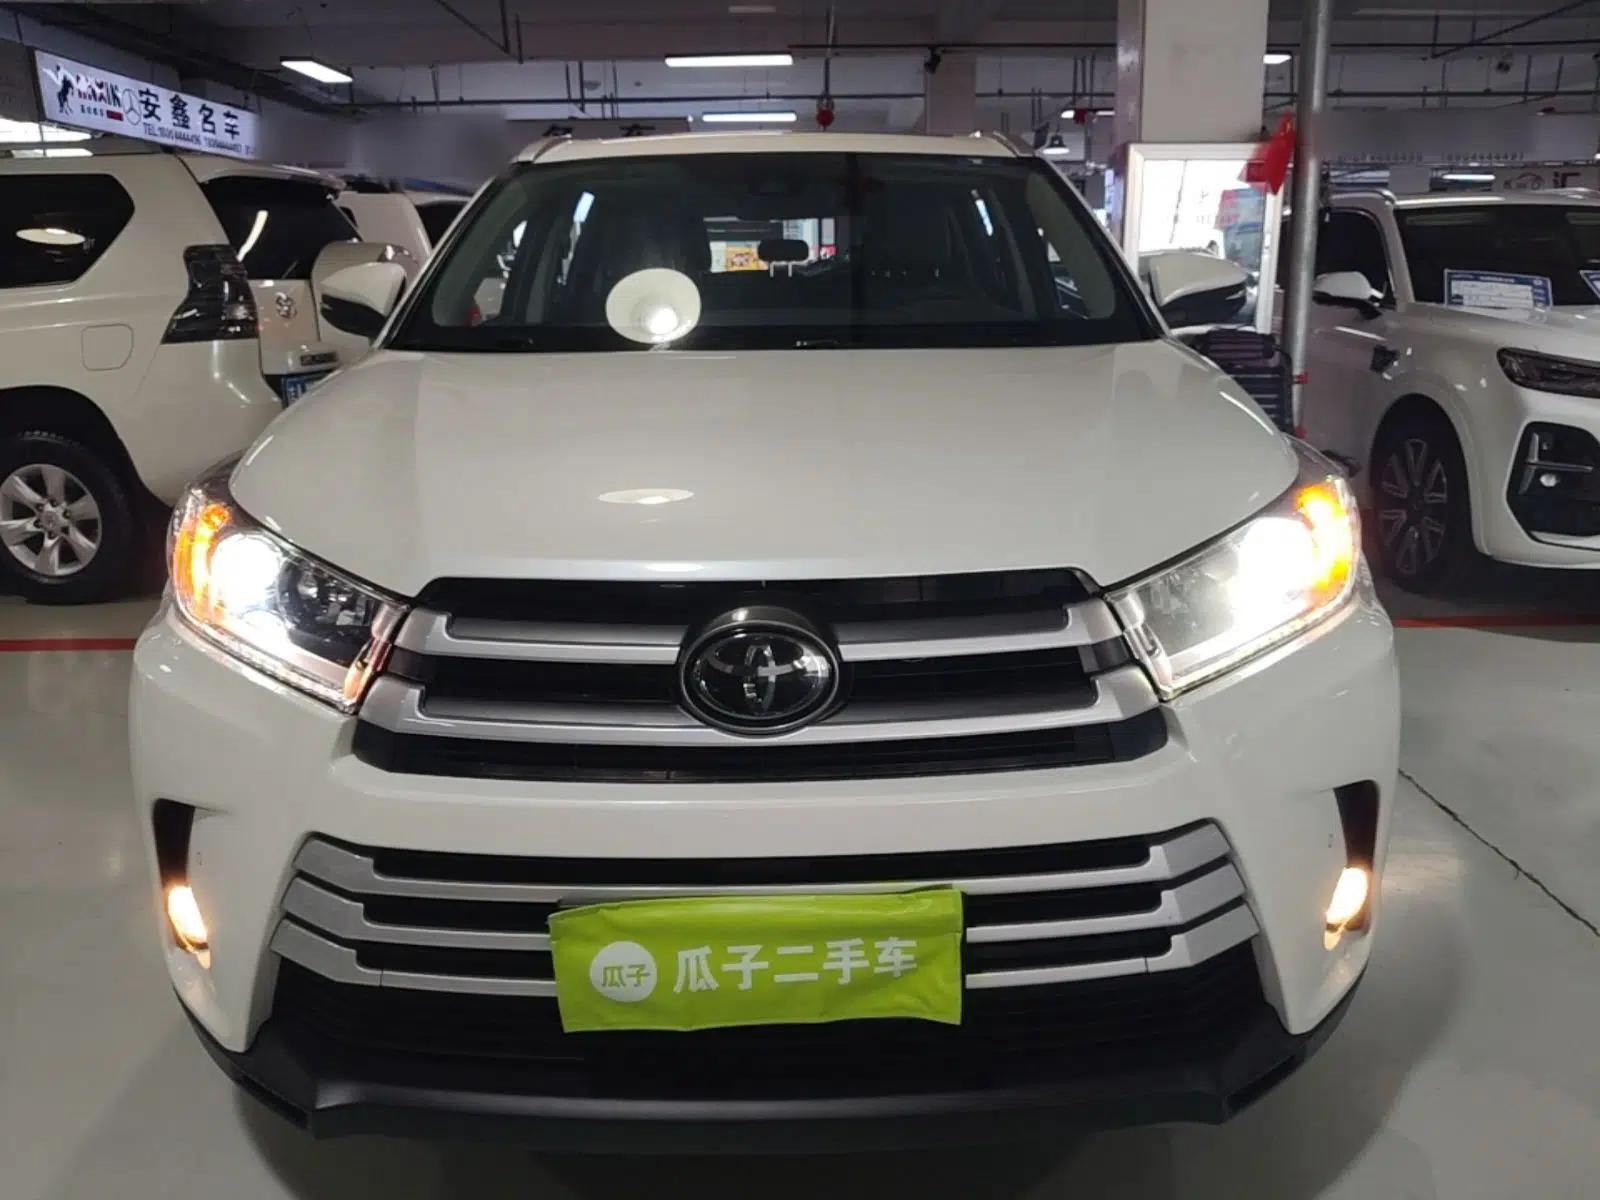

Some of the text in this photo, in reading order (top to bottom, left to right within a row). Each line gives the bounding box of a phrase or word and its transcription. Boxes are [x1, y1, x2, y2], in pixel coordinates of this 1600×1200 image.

[138, 88, 240, 140] 安鑫名车
[602, 963, 651, 988] 瓜子
[672, 936, 918, 994] 瓜子二手车
